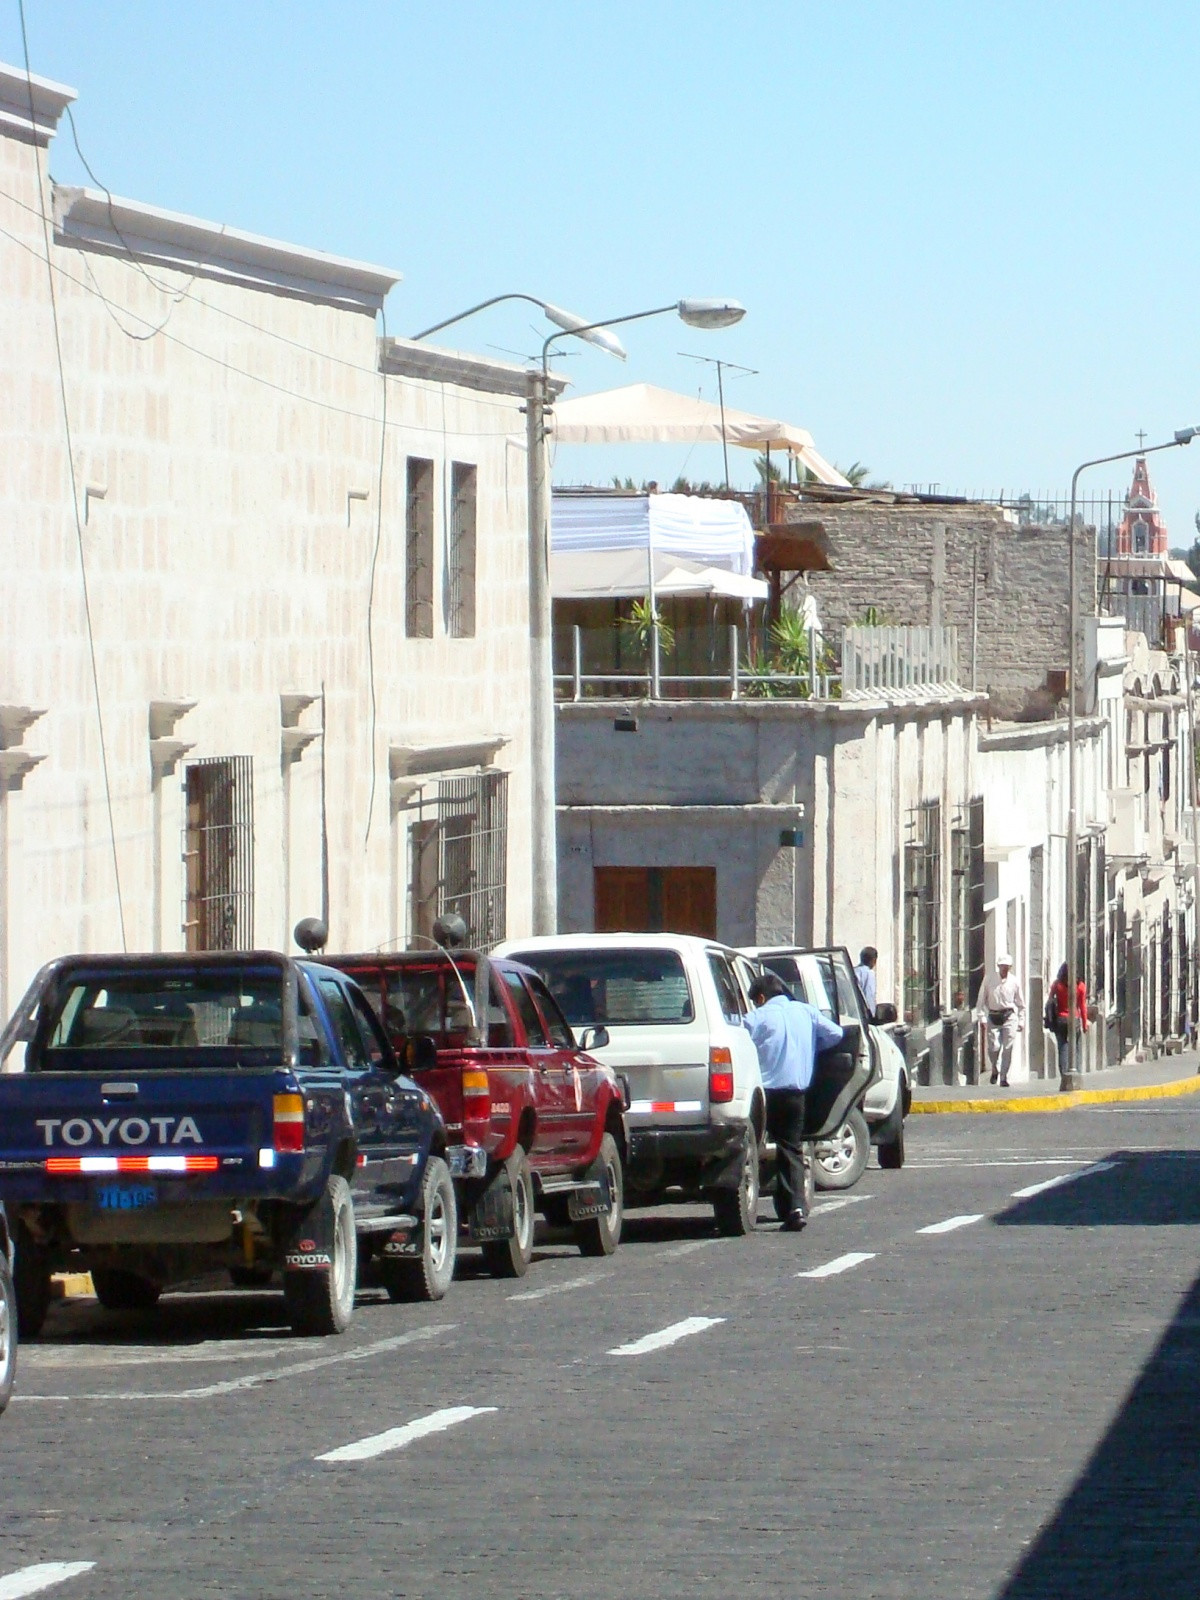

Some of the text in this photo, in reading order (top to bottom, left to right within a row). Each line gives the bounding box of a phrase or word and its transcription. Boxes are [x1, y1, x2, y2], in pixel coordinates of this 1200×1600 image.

[36, 1116, 204, 1146] TOYOTA
[573, 1204, 609, 1216] TOYOTA
[285, 1254, 332, 1264] TOYOTA
